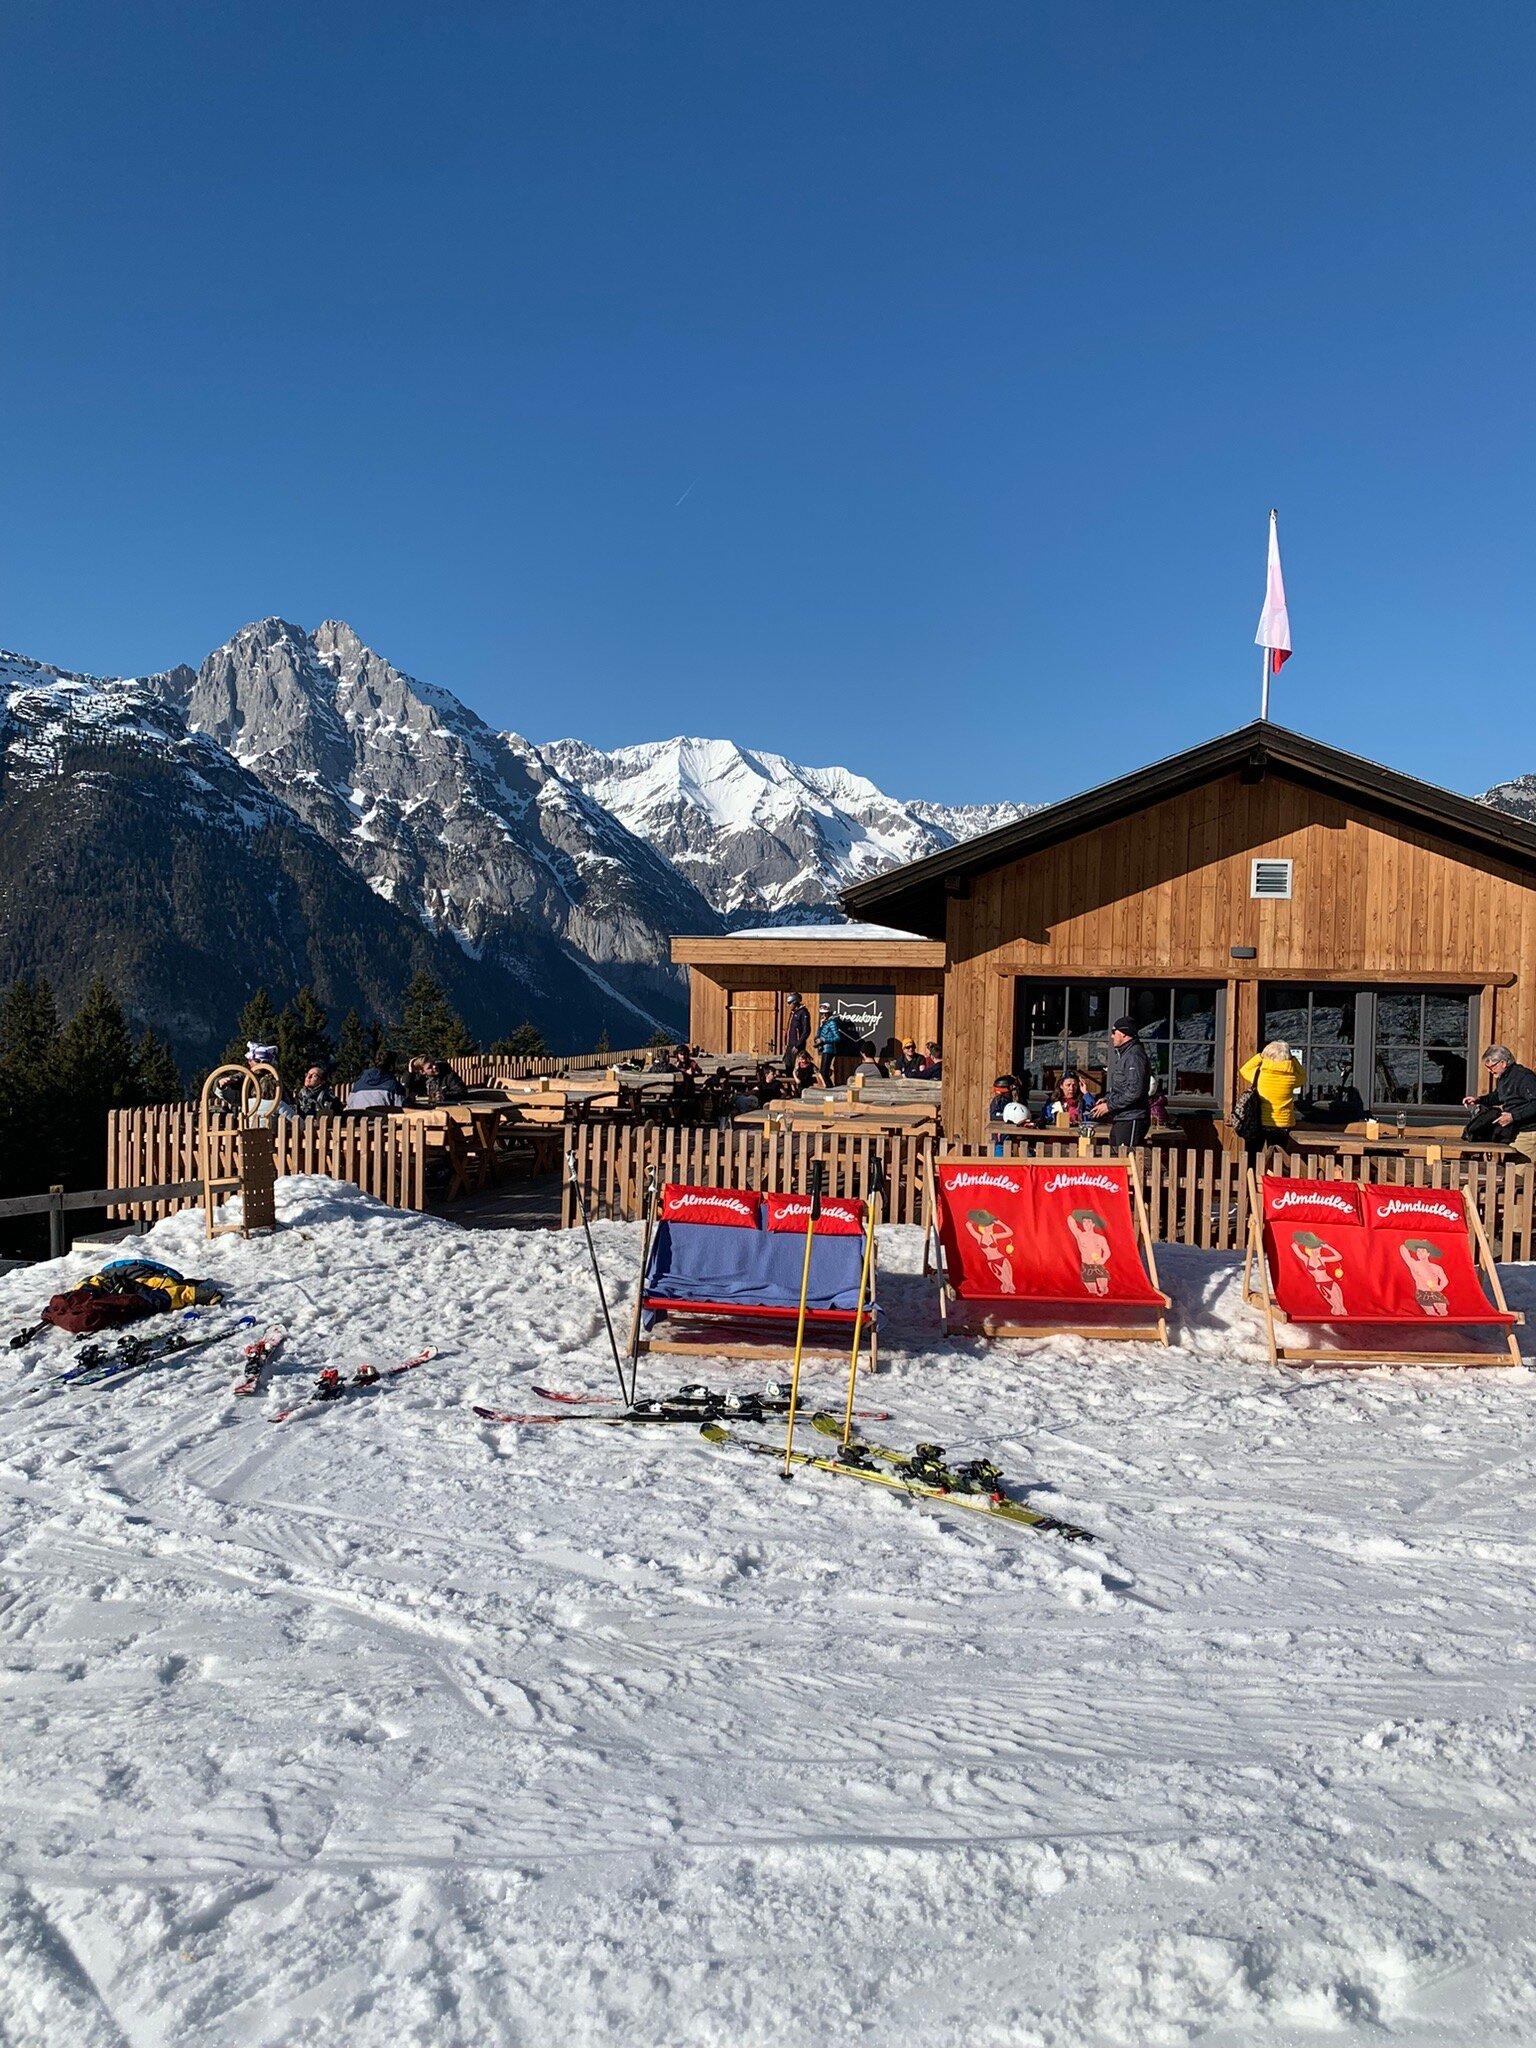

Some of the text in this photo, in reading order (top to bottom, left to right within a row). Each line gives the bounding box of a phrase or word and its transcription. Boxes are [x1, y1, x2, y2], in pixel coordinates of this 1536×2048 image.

[943, 1172, 1020, 1193] Almdudler
[1044, 1172, 1119, 1193] Almdudler
[669, 1193, 751, 1215] Almdudler
[774, 1203, 855, 1222] Almudler
[1272, 1191, 1354, 1214] Almdudler
[1376, 1199, 1459, 1222] Almdudler
